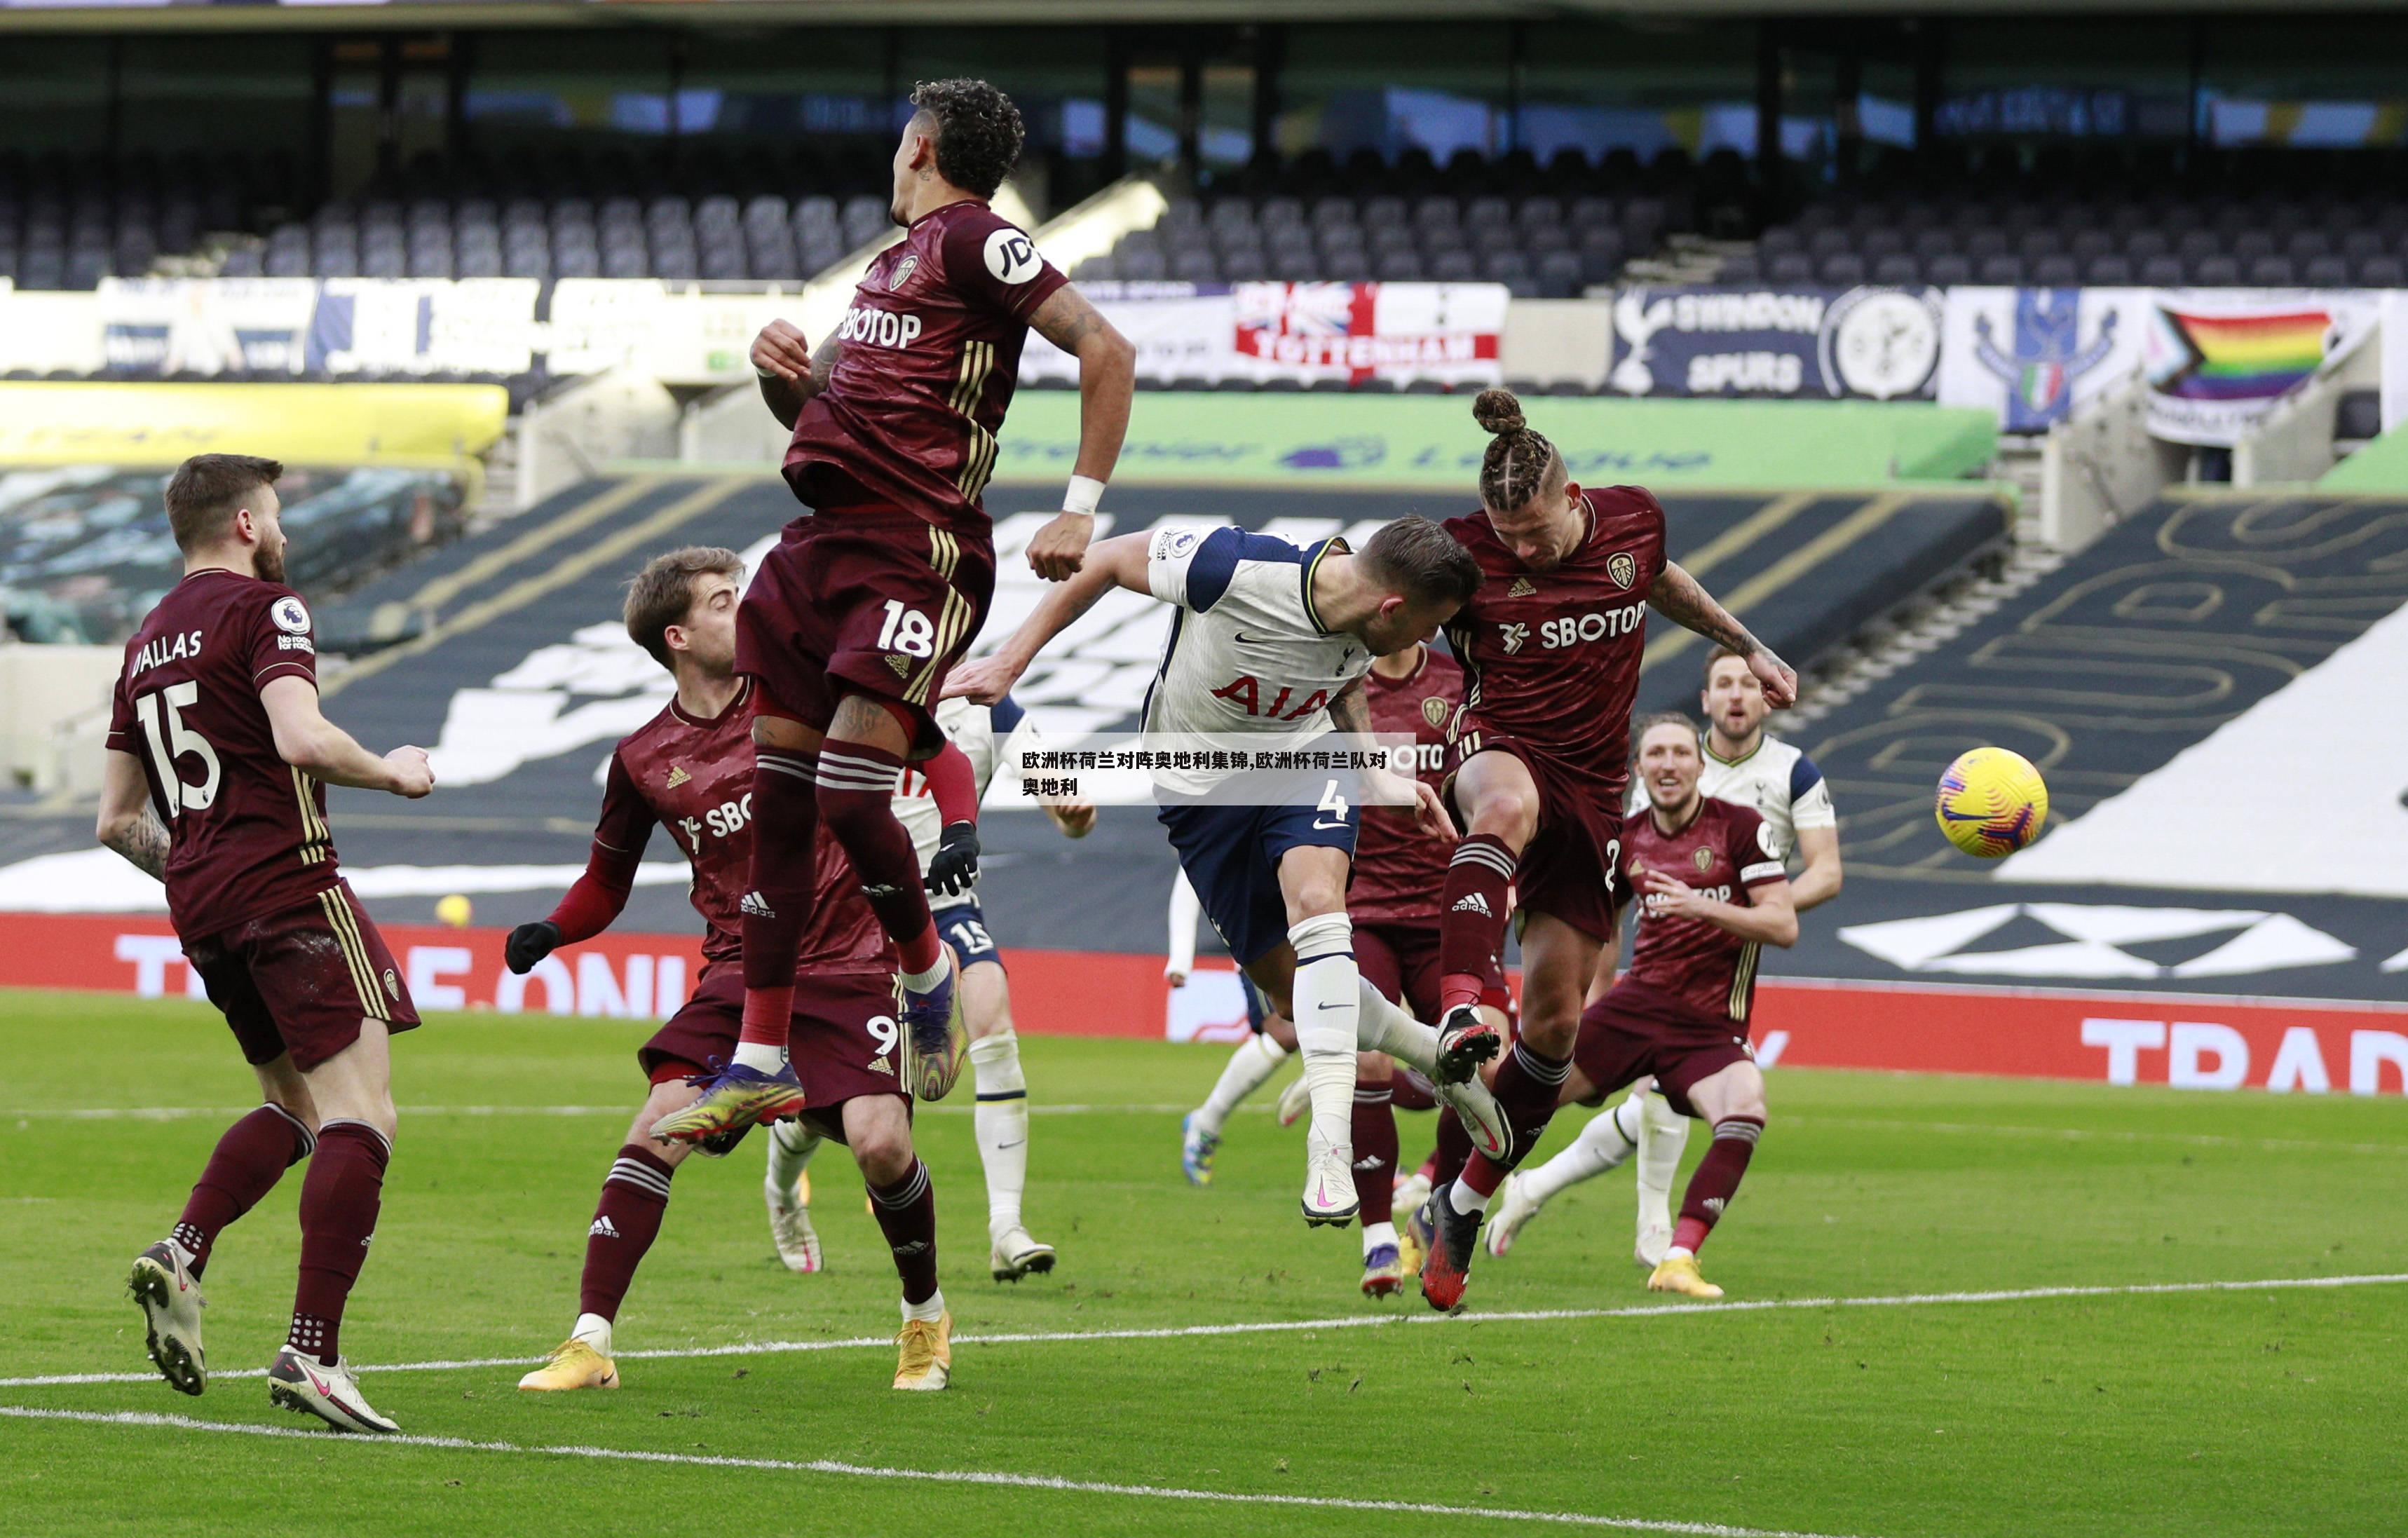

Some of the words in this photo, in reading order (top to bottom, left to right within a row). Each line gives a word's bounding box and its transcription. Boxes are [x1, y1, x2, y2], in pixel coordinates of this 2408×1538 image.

[999, 237, 1033, 278] JD
[838, 308, 922, 348] BOTOP
[1674, 292, 1824, 335] SWINDON
[1687, 352, 1802, 393] SPURS
[1509, 587, 1537, 598] adidas
[877, 599, 934, 658] 18
[1541, 599, 1647, 649] SBOTOP
[131, 630, 203, 679] DALLAS
[1210, 676, 1327, 721] AIA
[136, 680, 221, 818] 15
[1317, 780, 1349, 822] 4
[950, 919, 994, 954] 15
[866, 1015, 899, 1055] 9
